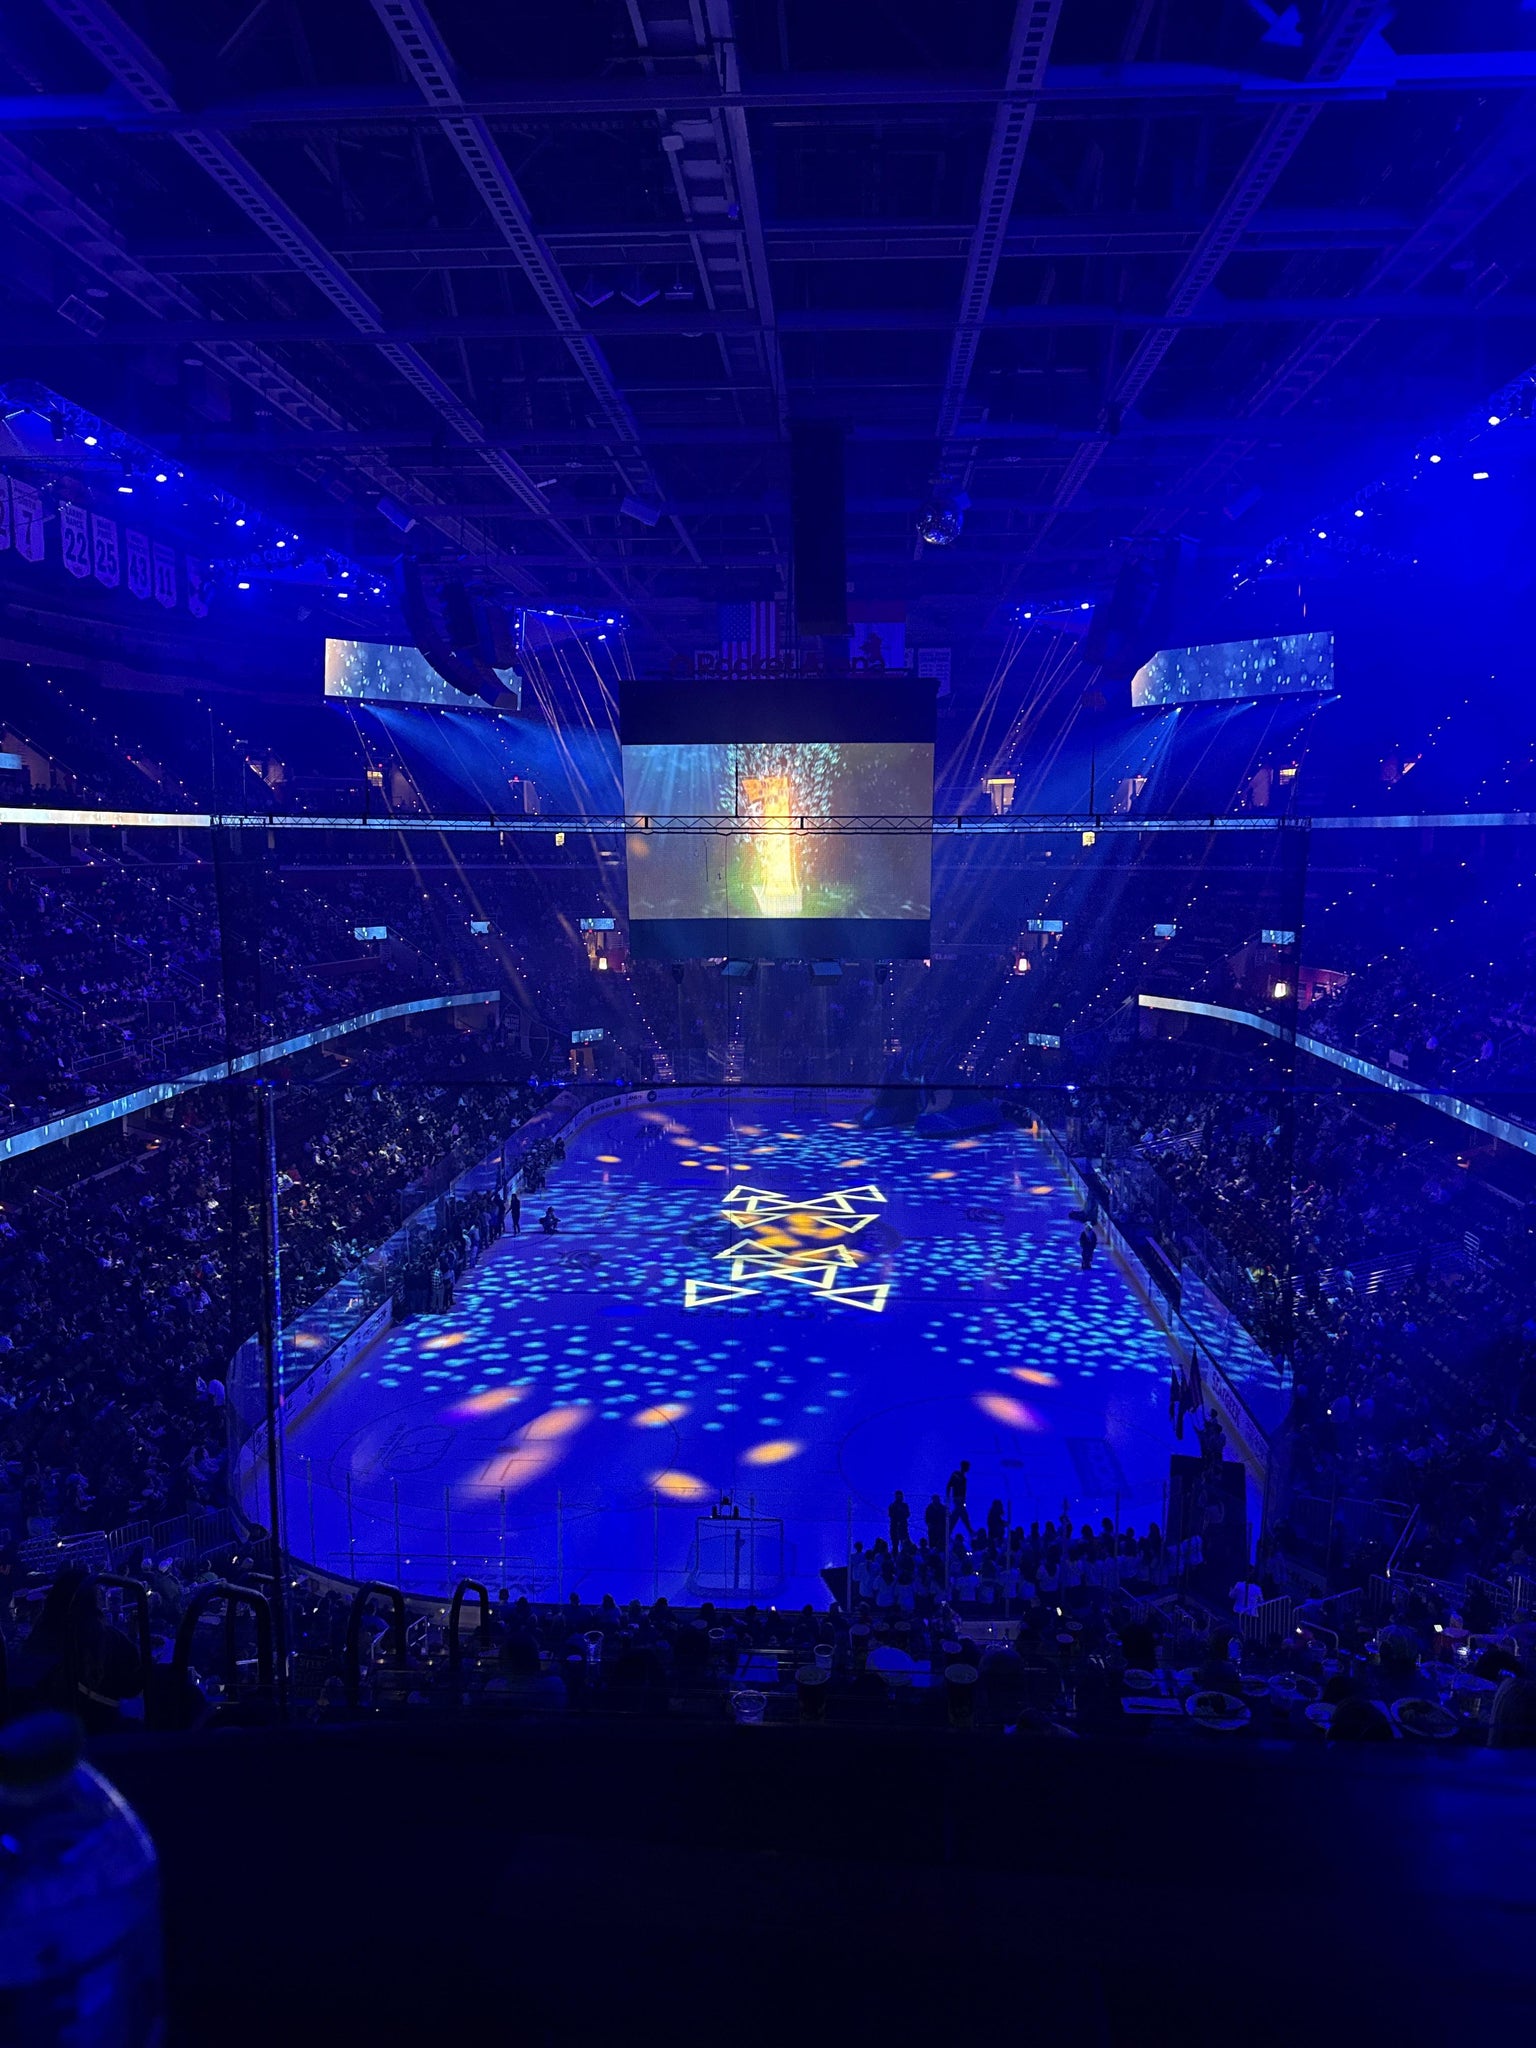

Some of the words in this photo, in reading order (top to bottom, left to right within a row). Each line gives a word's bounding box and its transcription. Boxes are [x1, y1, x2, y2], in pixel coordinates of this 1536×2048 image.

[22, 509, 33, 545] 7
[65, 528, 88, 565] 22
[96, 540, 116, 575] 25
[130, 553, 147, 588] 43
[158, 566, 171, 596] 11
[696, 651, 795, 672] Rocket
